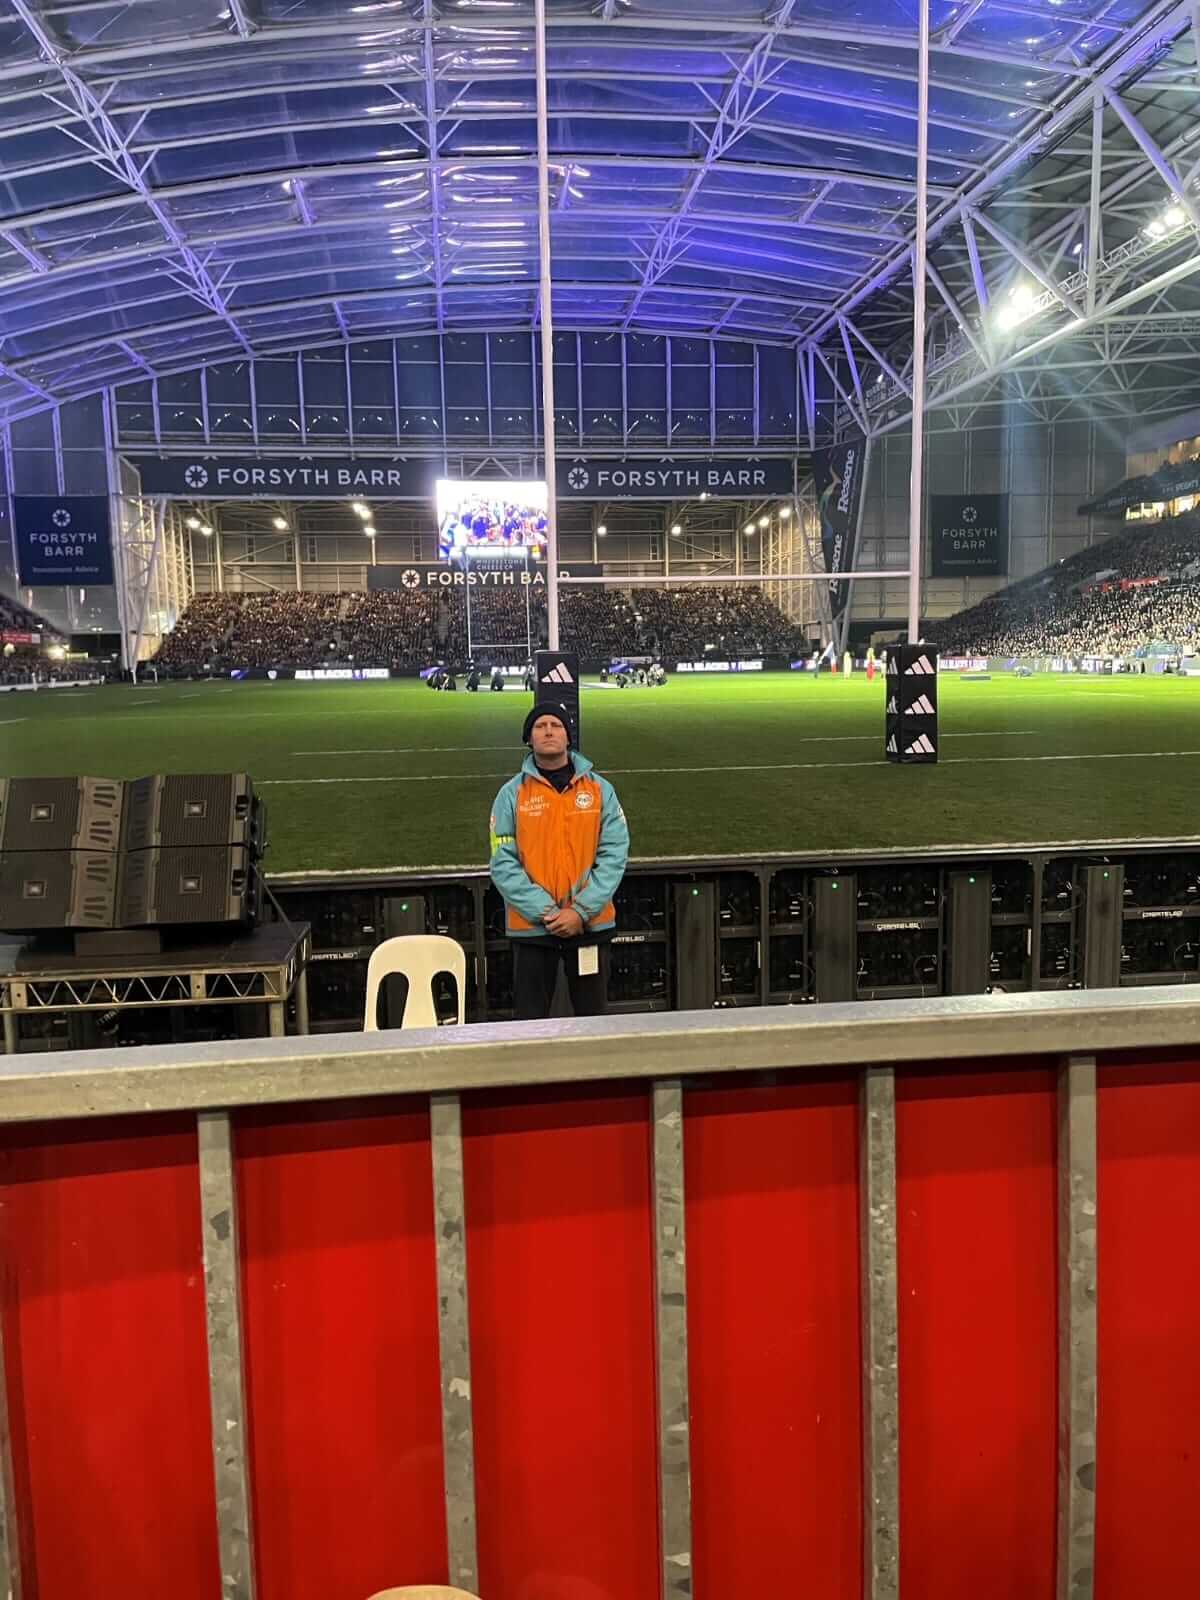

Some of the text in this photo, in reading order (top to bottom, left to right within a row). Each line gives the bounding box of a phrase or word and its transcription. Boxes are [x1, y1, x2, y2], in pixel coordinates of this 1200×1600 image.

[217, 468, 401, 486] FORSYTH BARR
[598, 470, 765, 486] FORSYTH BARR
[836, 449, 856, 513] Resene
[30, 532, 97, 544] FORSYTH
[942, 528, 998, 538] FORSYTH
[44, 546, 84, 557] BARR
[953, 540, 986, 550] BARR
[829, 534, 843, 594] Rsene
[427, 571, 570, 585] FORSYTH BAR
